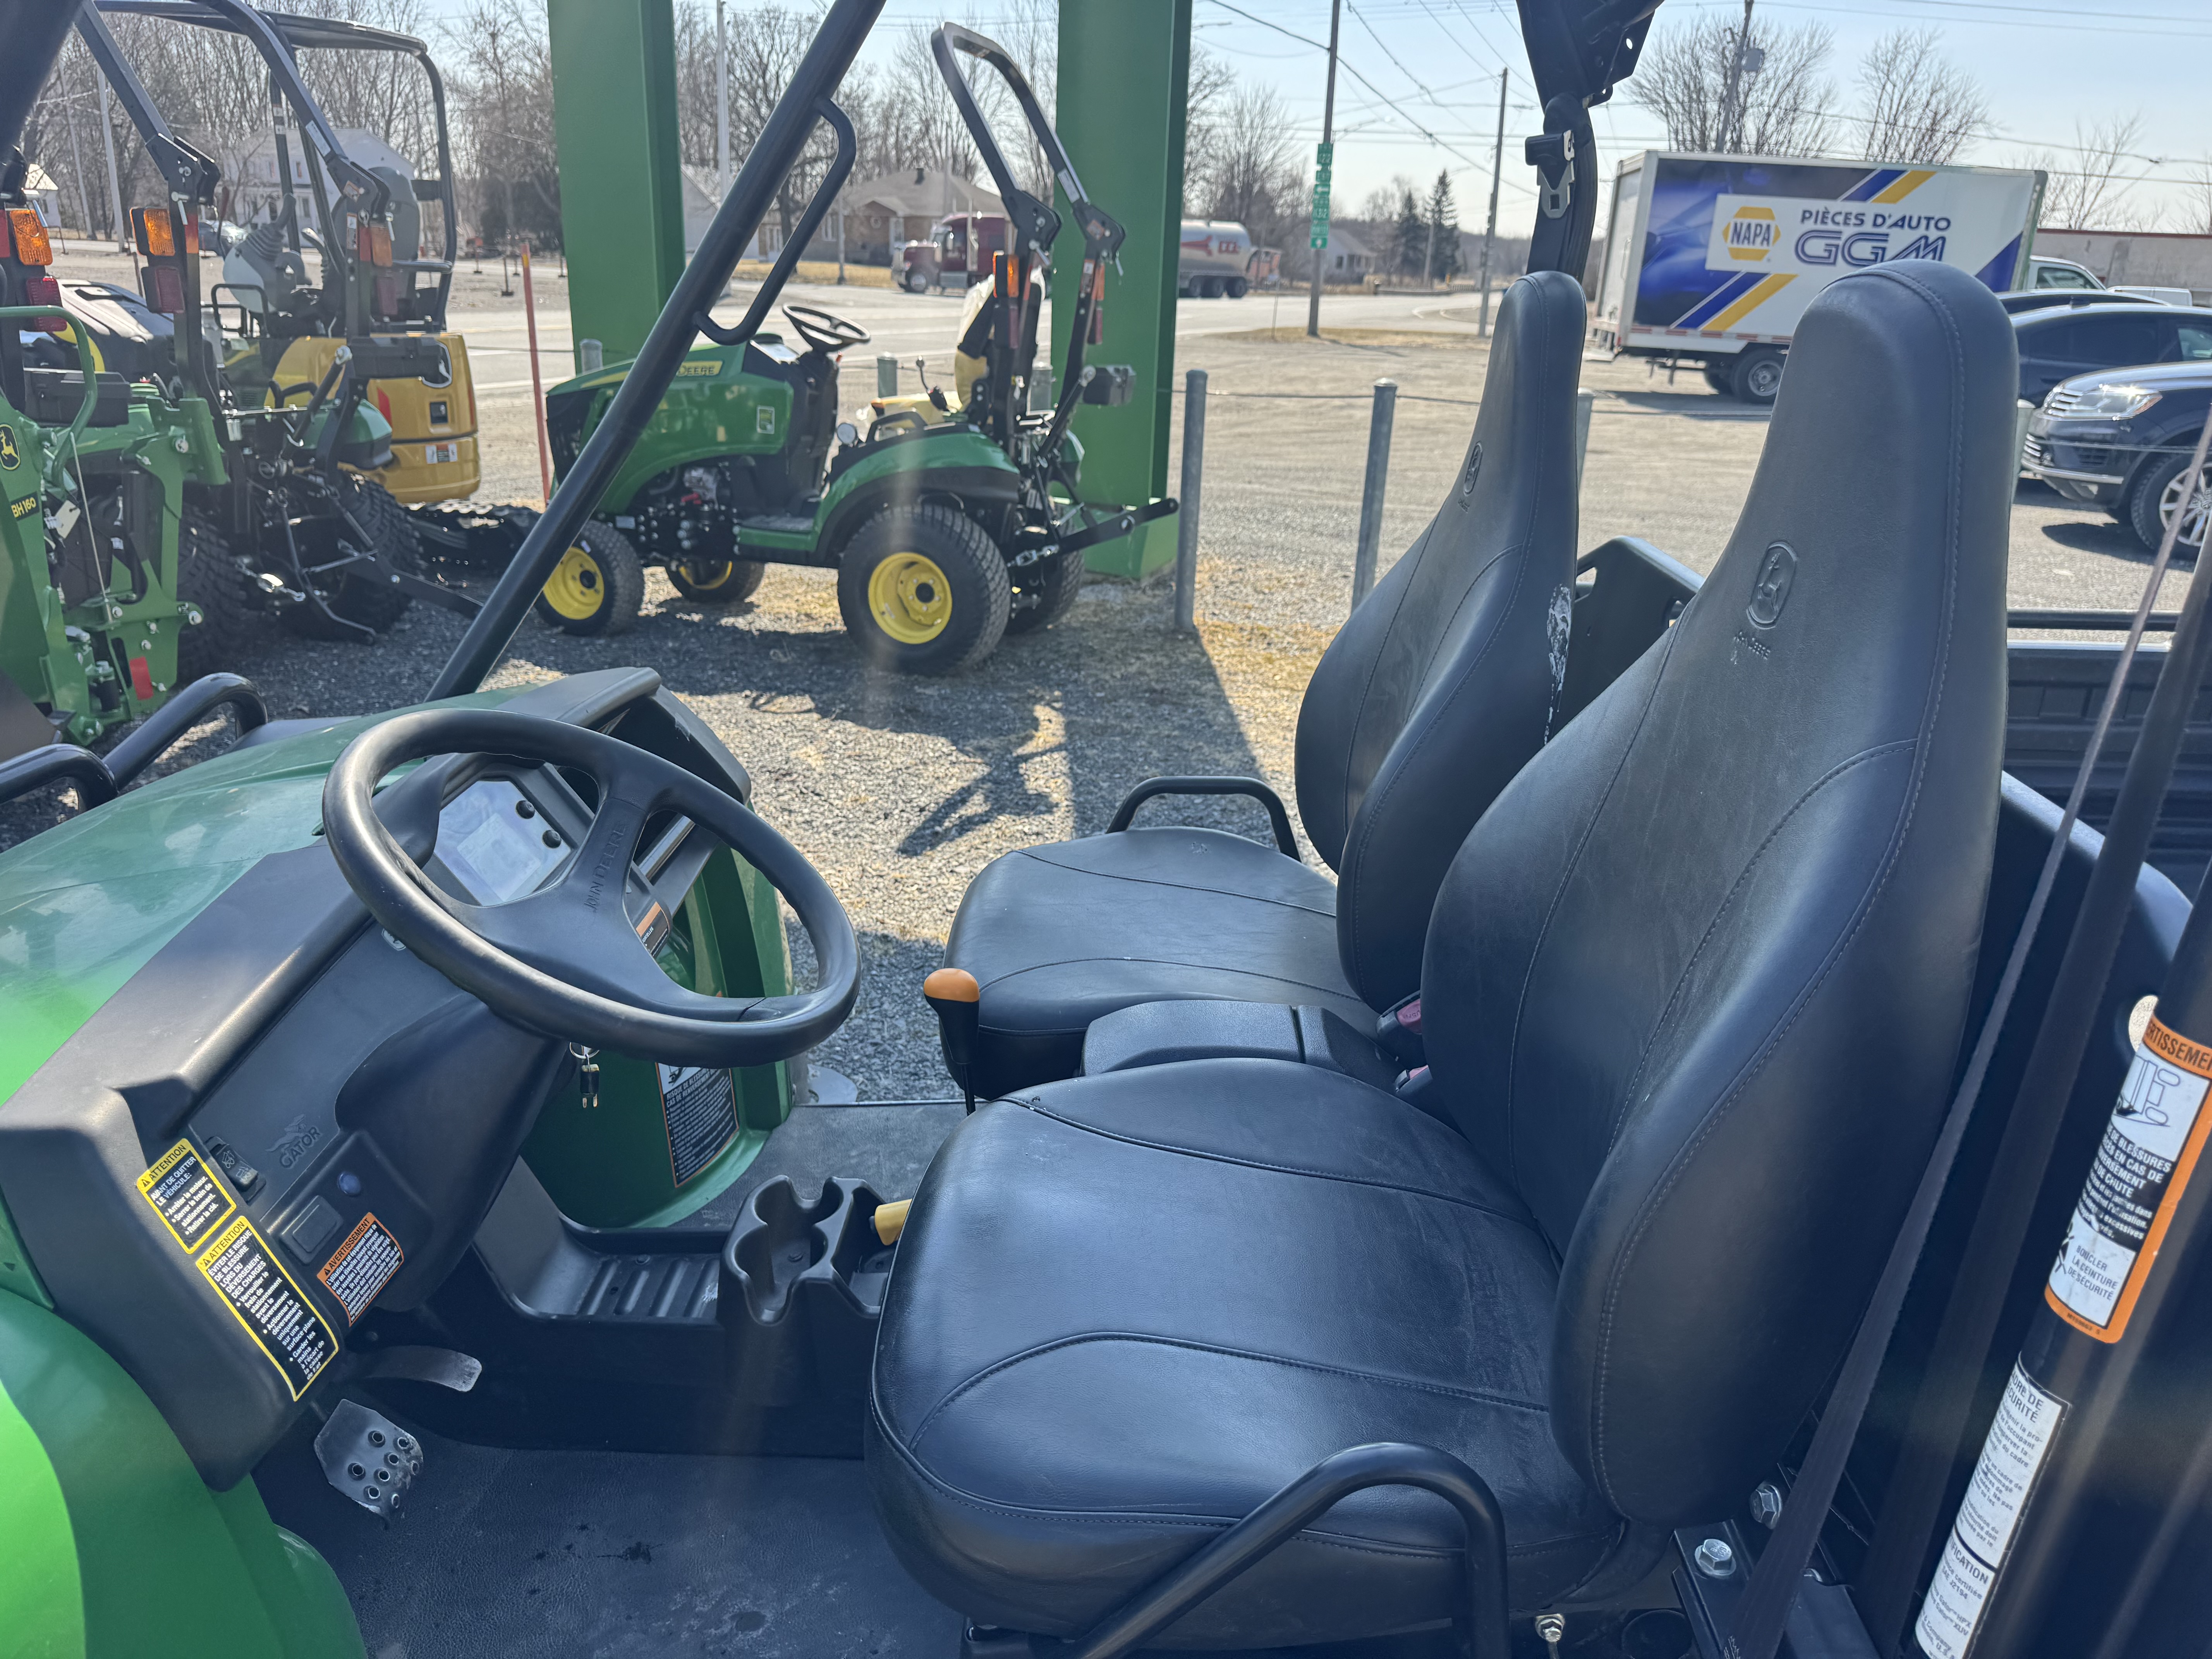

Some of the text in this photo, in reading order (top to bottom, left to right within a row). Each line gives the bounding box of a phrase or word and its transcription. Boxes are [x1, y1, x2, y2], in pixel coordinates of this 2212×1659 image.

[1730, 221, 1772, 247] NAPA
[1800, 207, 1951, 232] PIÈCES D'AUTO
[1794, 229, 1947, 267] GGM
[148, 1144, 186, 1180] ATTENTION
[277, 1125, 320, 1169] GATOR
[2118, 1137, 2172, 1173] BLESSURES
[150, 1156, 196, 1200] AVANT DE QUITTER
[2105, 1173, 2134, 1198] CHUTE
[2126, 1159, 2147, 1176] CAS
[2147, 1169, 2164, 1183] DE
[156, 1171, 192, 1206] LE VÉHICULE:
[167, 1175, 208, 1214] Arrêter le moteur.
[173, 1182, 213, 1221] Serrer le frein de
[180, 1192, 216, 1227] stationnement.
[187, 1215, 206, 1233] Retirer
[207, 1230, 252, 1276] ÉVITER LE RISQUE
[208, 1221, 245, 1259] ATTENTION
[328, 1218, 370, 1269] AVERTISSEMENT
[214, 1245, 249, 1281] DE BLESSURE
[224, 1253, 263, 1293] DÉVERSEMENT
[2076, 1245, 2106, 1271] BOUCLER
[220, 1262, 243, 1287] LORS DU
[231, 1261, 267, 1298] DES CHARGES
[239, 1276, 264, 1302] Verrouiller
[2067, 1266, 2114, 1300] DE SÉCURITÉ
[2079, 1262, 2118, 1290] CEINTURE
[244, 1287, 264, 1308] frein de
[249, 1277, 283, 1313] stationnement
[254, 1303, 270, 1318] avant
[259, 1291, 290, 1323] déversement
[266, 1304, 290, 1330] Actionner
[270, 1302, 301, 1335] déversement
[275, 1310, 304, 1340] uniquement
[286, 1316, 317, 1350] surface plane
[282, 1325, 300, 1345] sur une
[292, 1330, 316, 1357] Garder les
[316, 1340, 325, 1348] de
[296, 1346, 312, 1363] mains
[2028, 1394, 2044, 1411] DE
[2009, 1451, 2029, 1468] cadre
